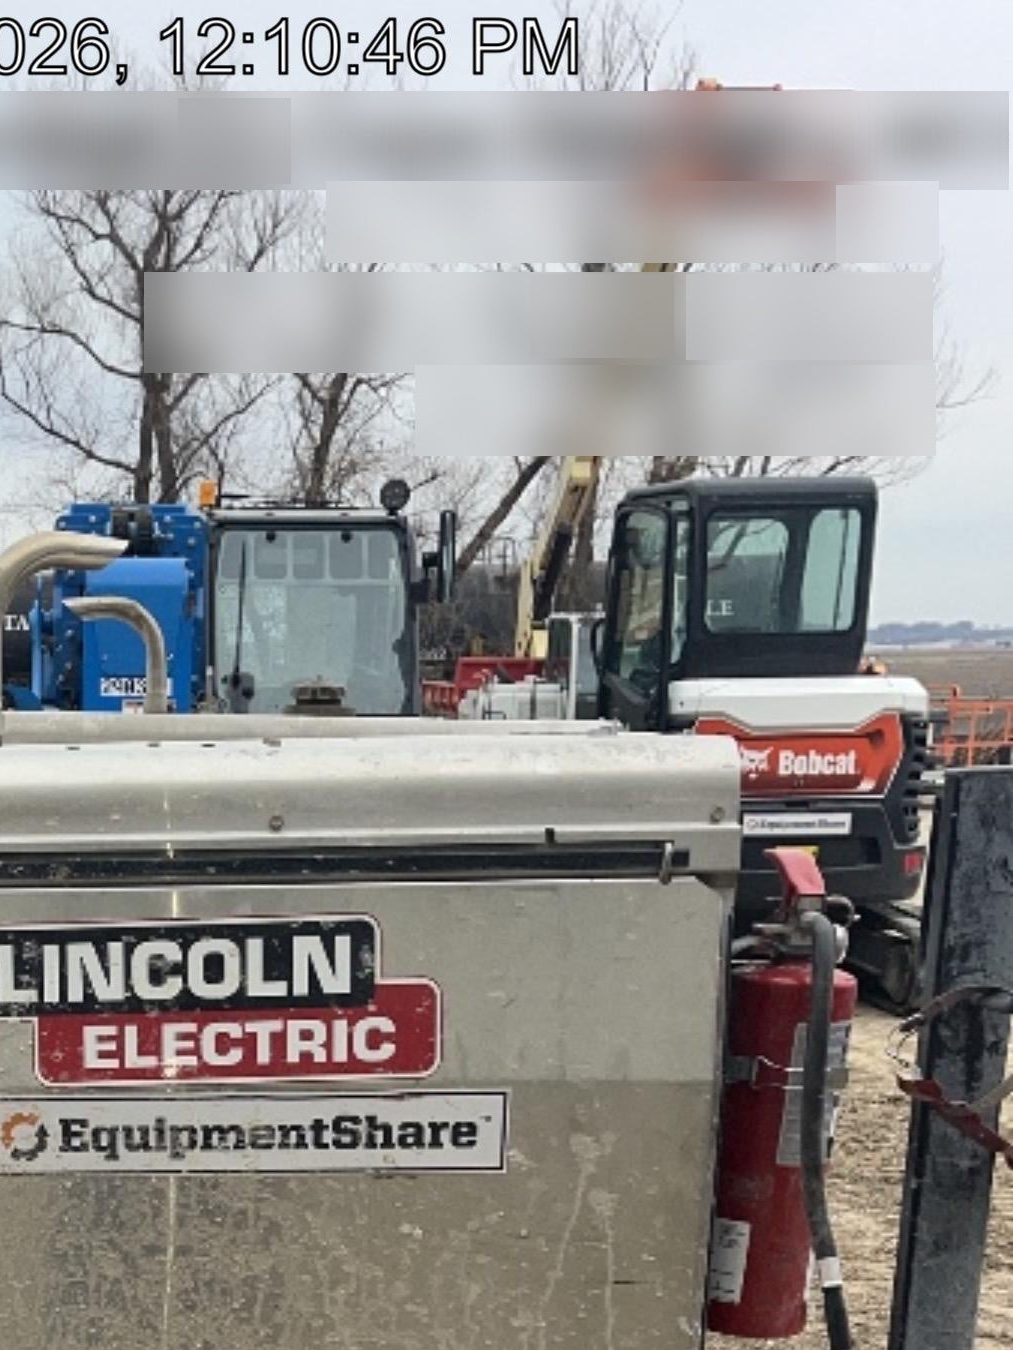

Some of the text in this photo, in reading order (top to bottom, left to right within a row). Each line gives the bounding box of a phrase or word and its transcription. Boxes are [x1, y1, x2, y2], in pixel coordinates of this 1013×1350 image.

[779, 750, 856, 775] Bobcat
[82, 1016, 396, 1070] ELECTRIC
[58, 1114, 478, 1159] EquipmentShare
